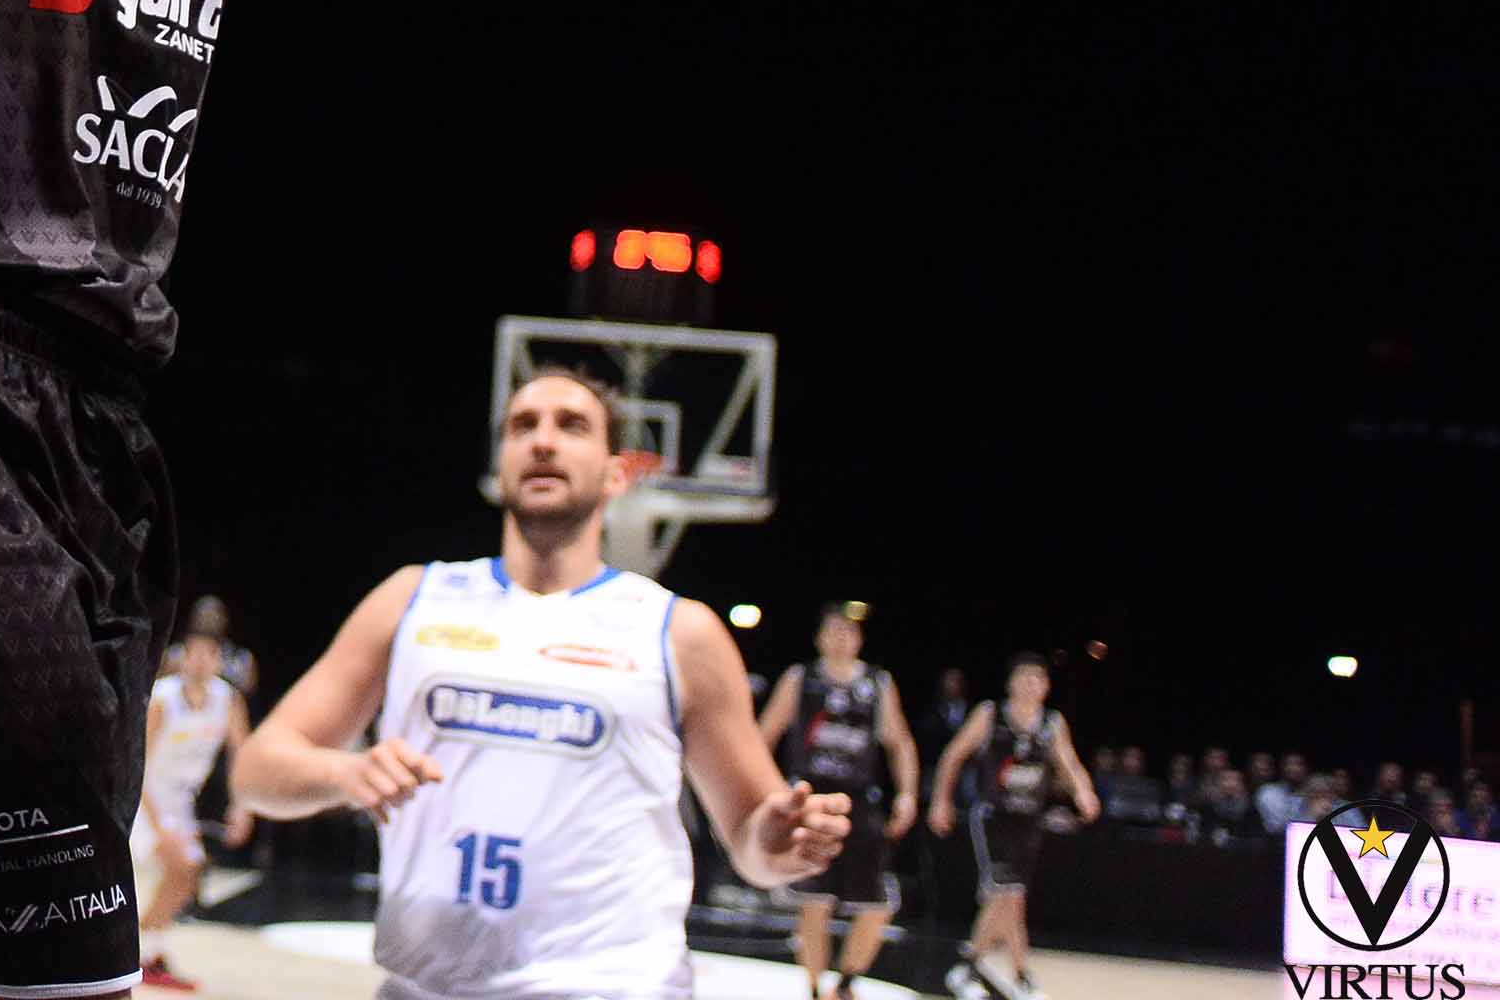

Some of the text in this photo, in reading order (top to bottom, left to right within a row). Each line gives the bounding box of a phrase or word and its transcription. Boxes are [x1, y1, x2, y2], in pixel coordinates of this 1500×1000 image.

[27, 844, 95, 867] HANDLING
[453, 831, 521, 910] 15
[68, 884, 128, 923] ITALIA
